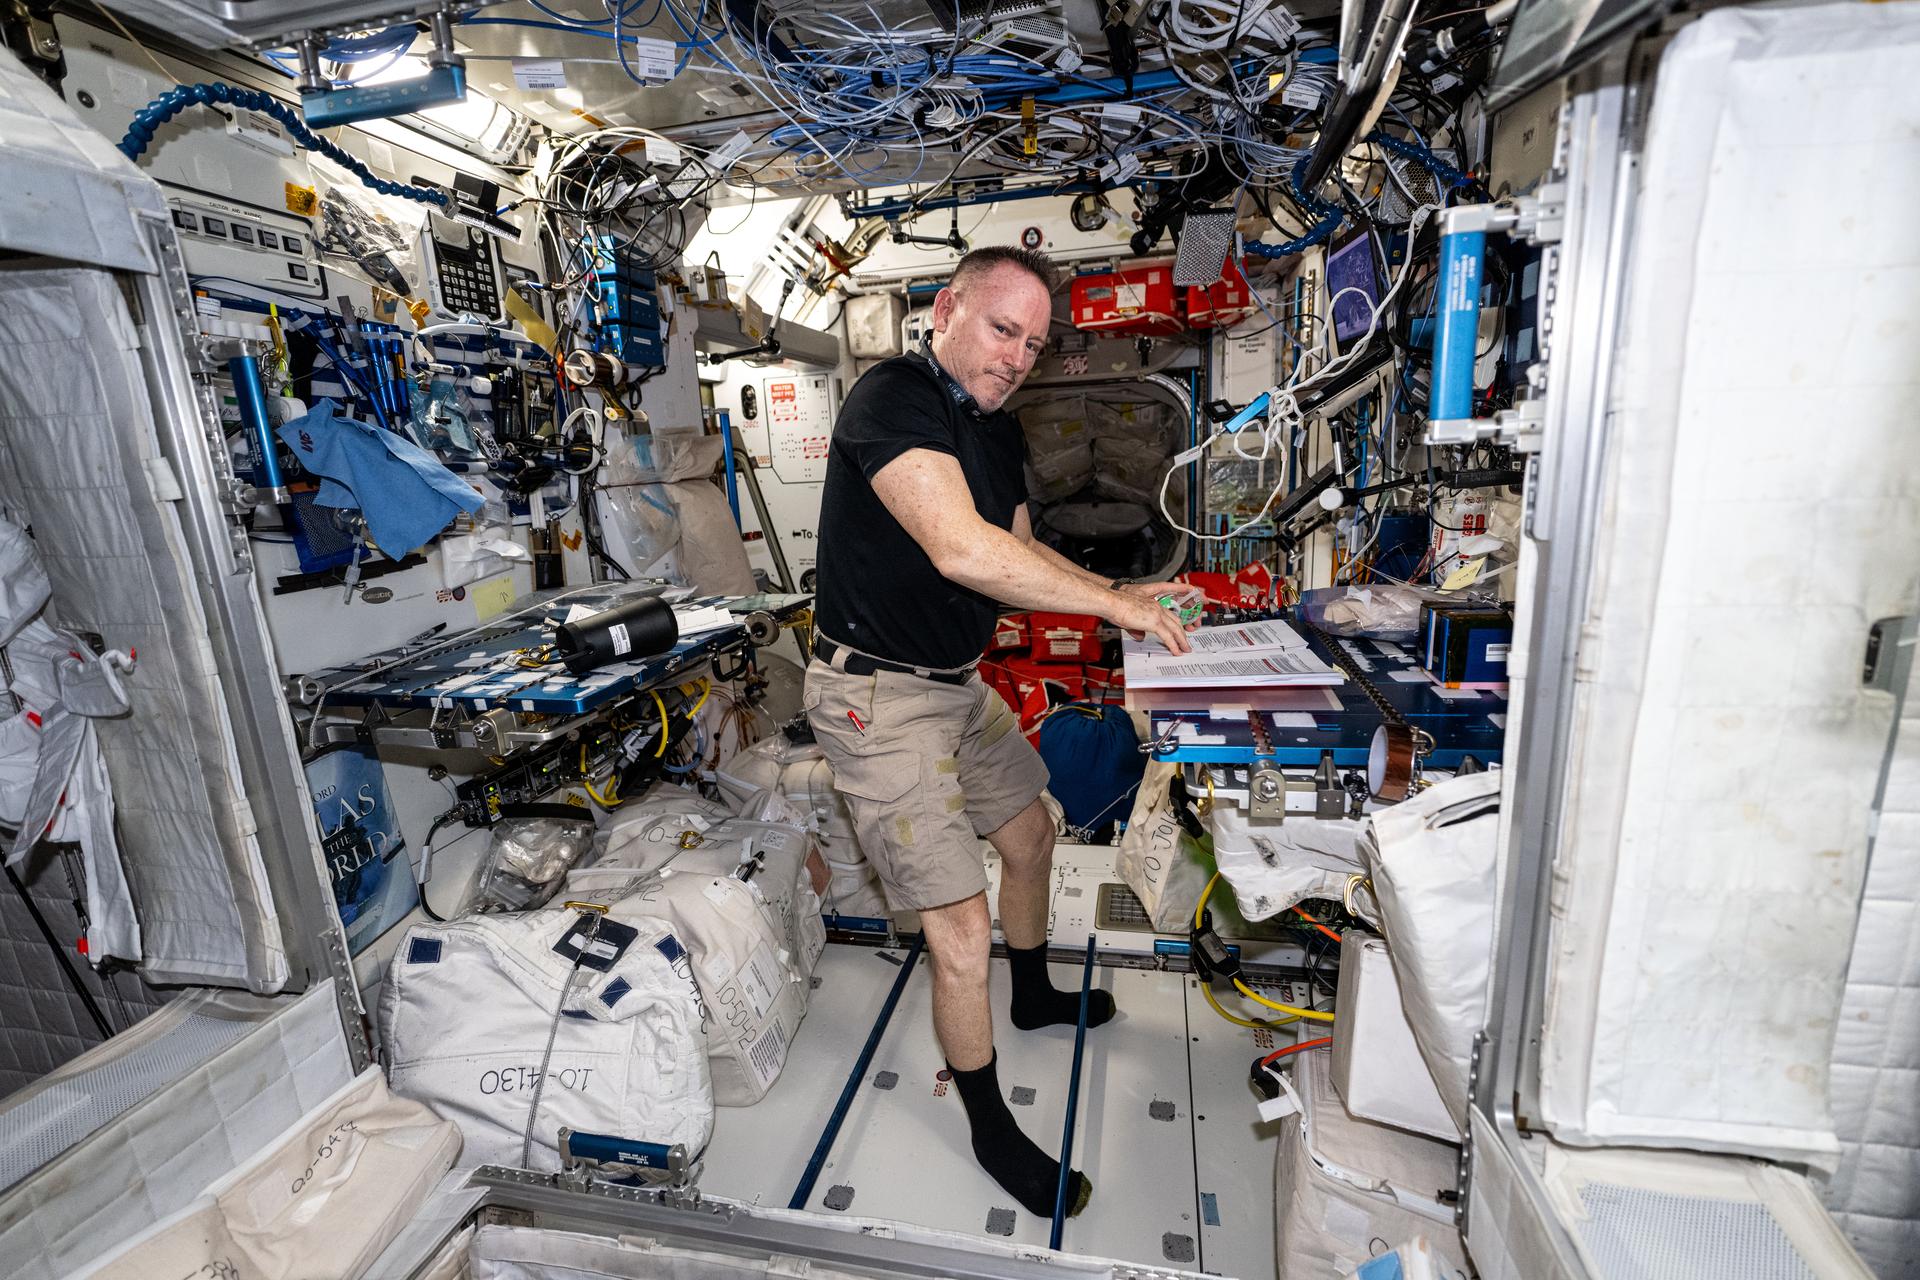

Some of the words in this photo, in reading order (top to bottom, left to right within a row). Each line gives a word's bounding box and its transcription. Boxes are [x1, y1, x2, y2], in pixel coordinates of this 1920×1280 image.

[1067, 360, 1084, 371] EXIT
[801, 529, 813, 539] To
[327, 833, 352, 854] THE
[715, 979, 758, 1051] 1.0-5042
